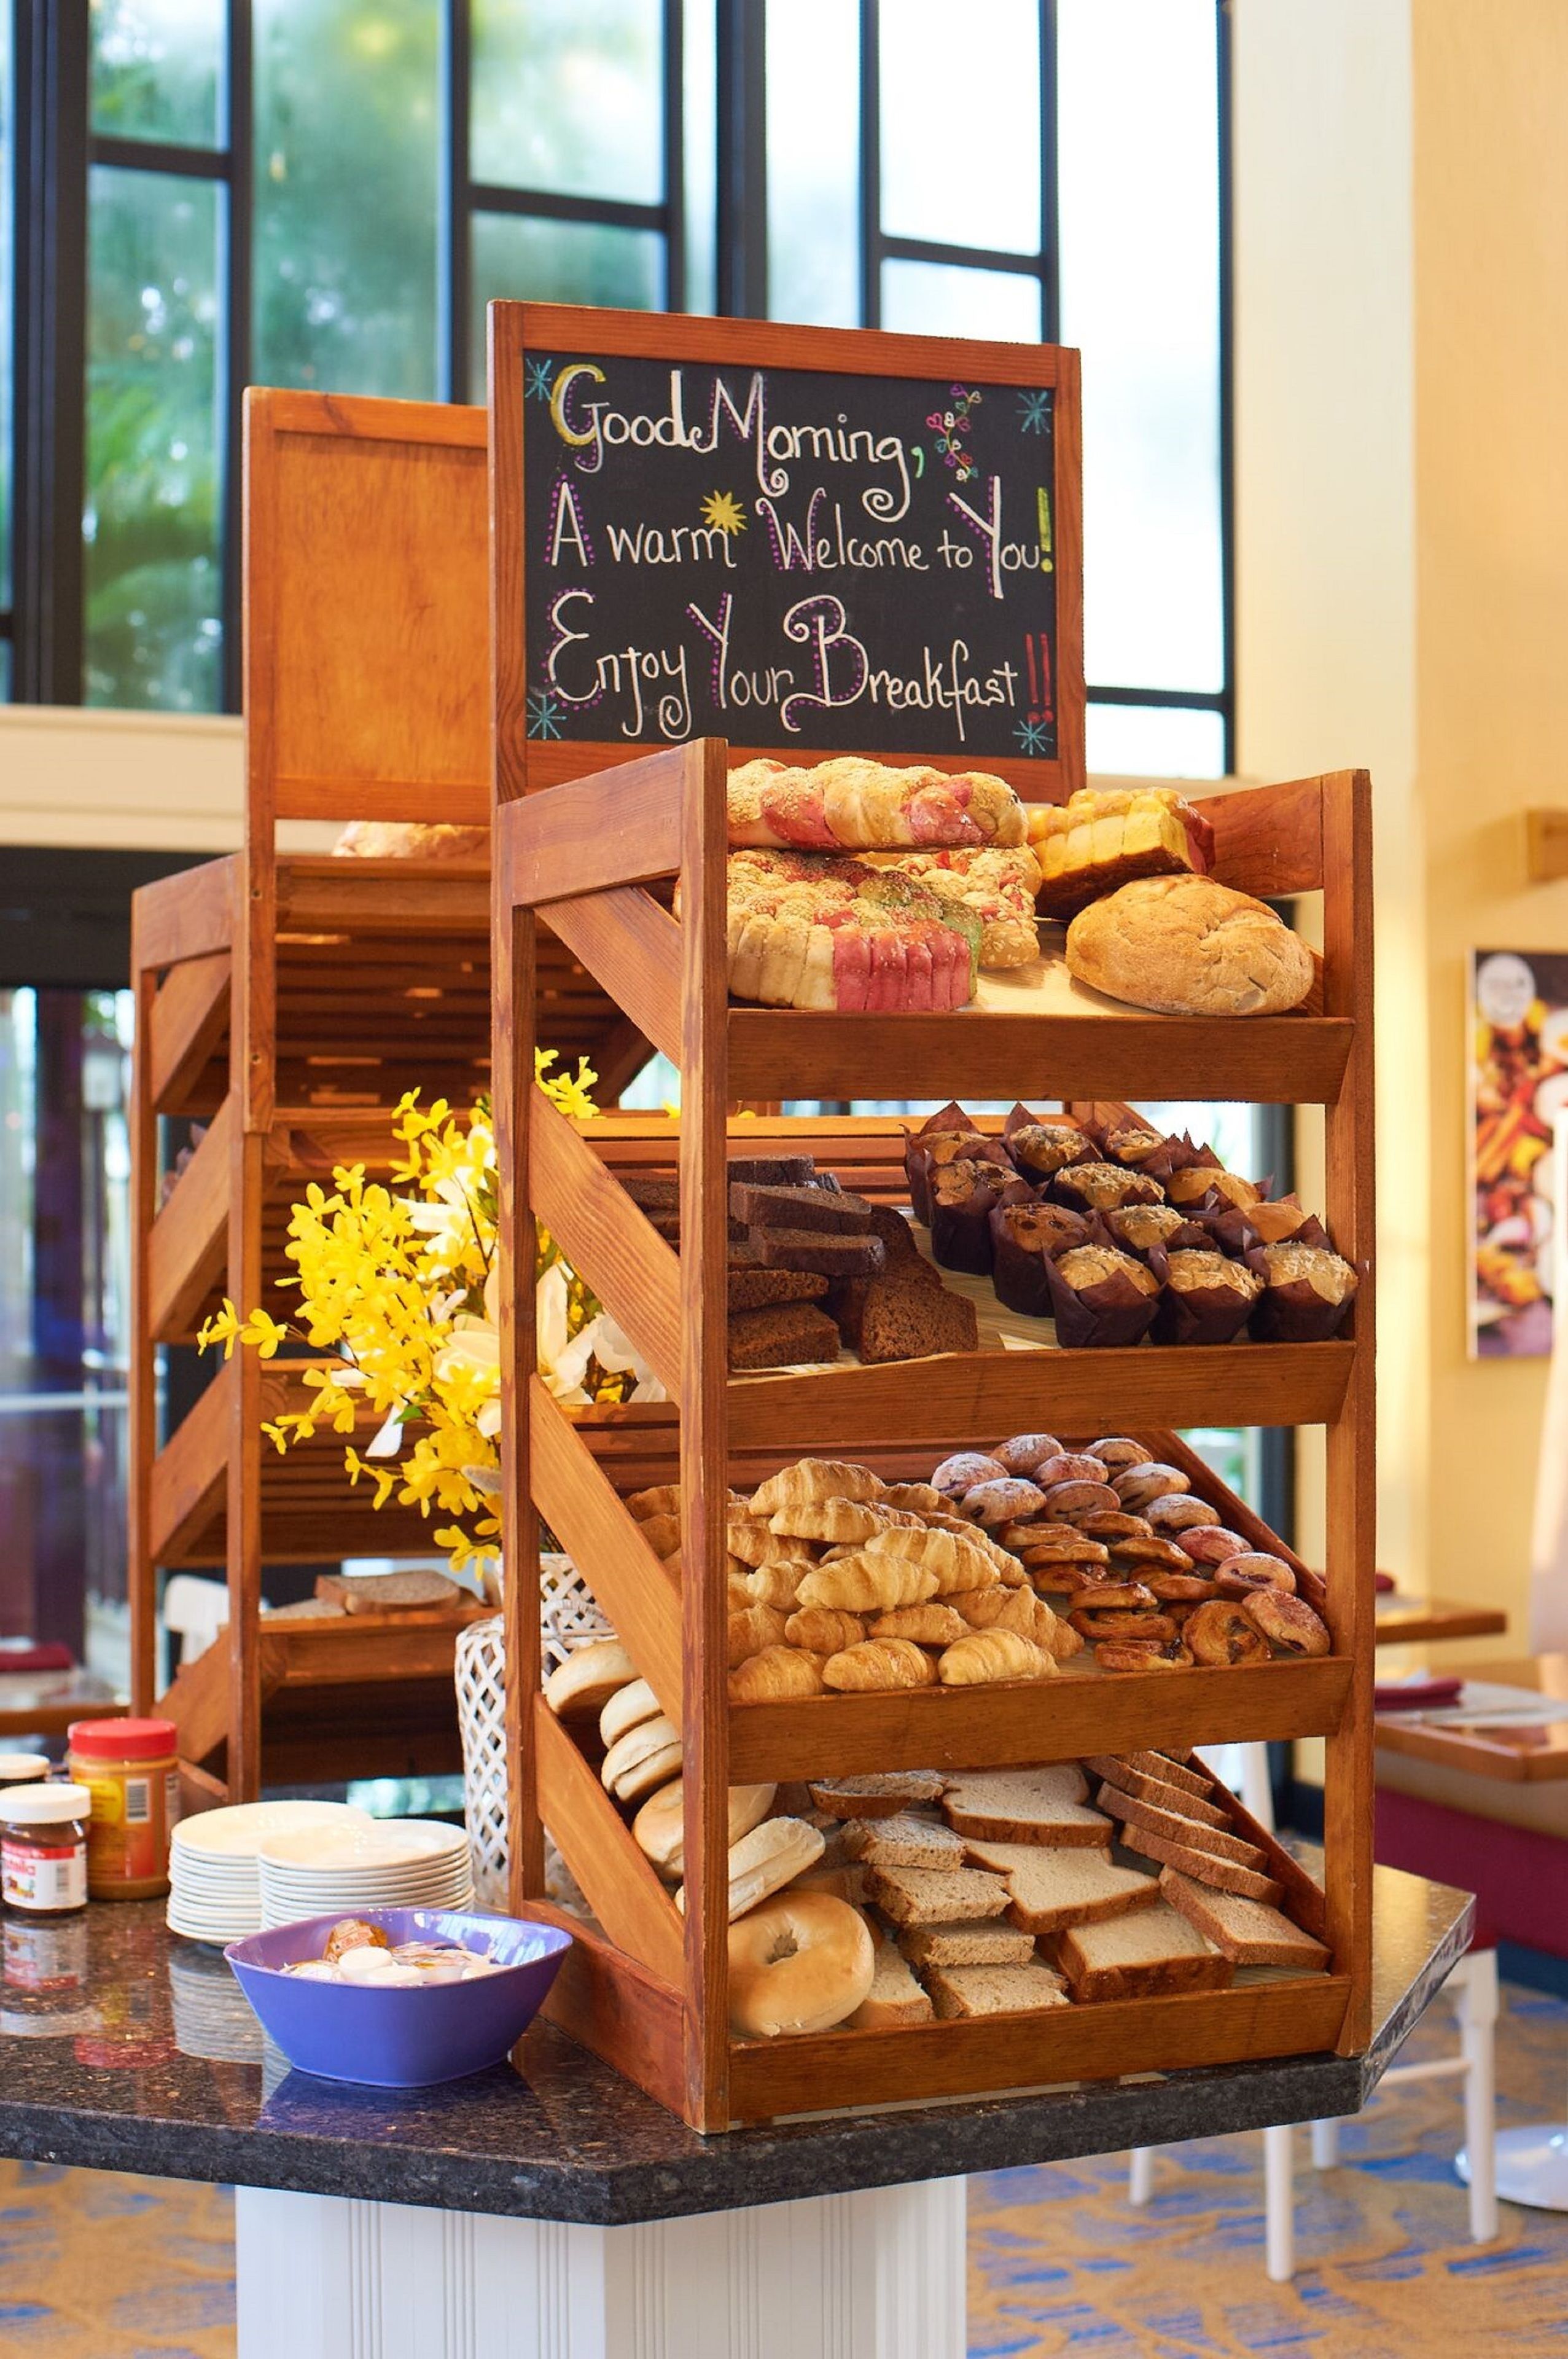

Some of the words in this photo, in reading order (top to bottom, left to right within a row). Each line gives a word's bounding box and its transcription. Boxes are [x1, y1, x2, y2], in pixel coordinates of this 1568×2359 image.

[550, 363, 691, 473] Good
[689, 372, 925, 523] Morning,
[547, 477, 591, 567] A
[606, 522, 738, 569] warm
[755, 488, 929, 573] Welcome
[937, 529, 973, 569] to
[946, 475, 1054, 600] You!
[542, 590, 692, 740] Enjoy
[686, 592, 795, 710] Your
